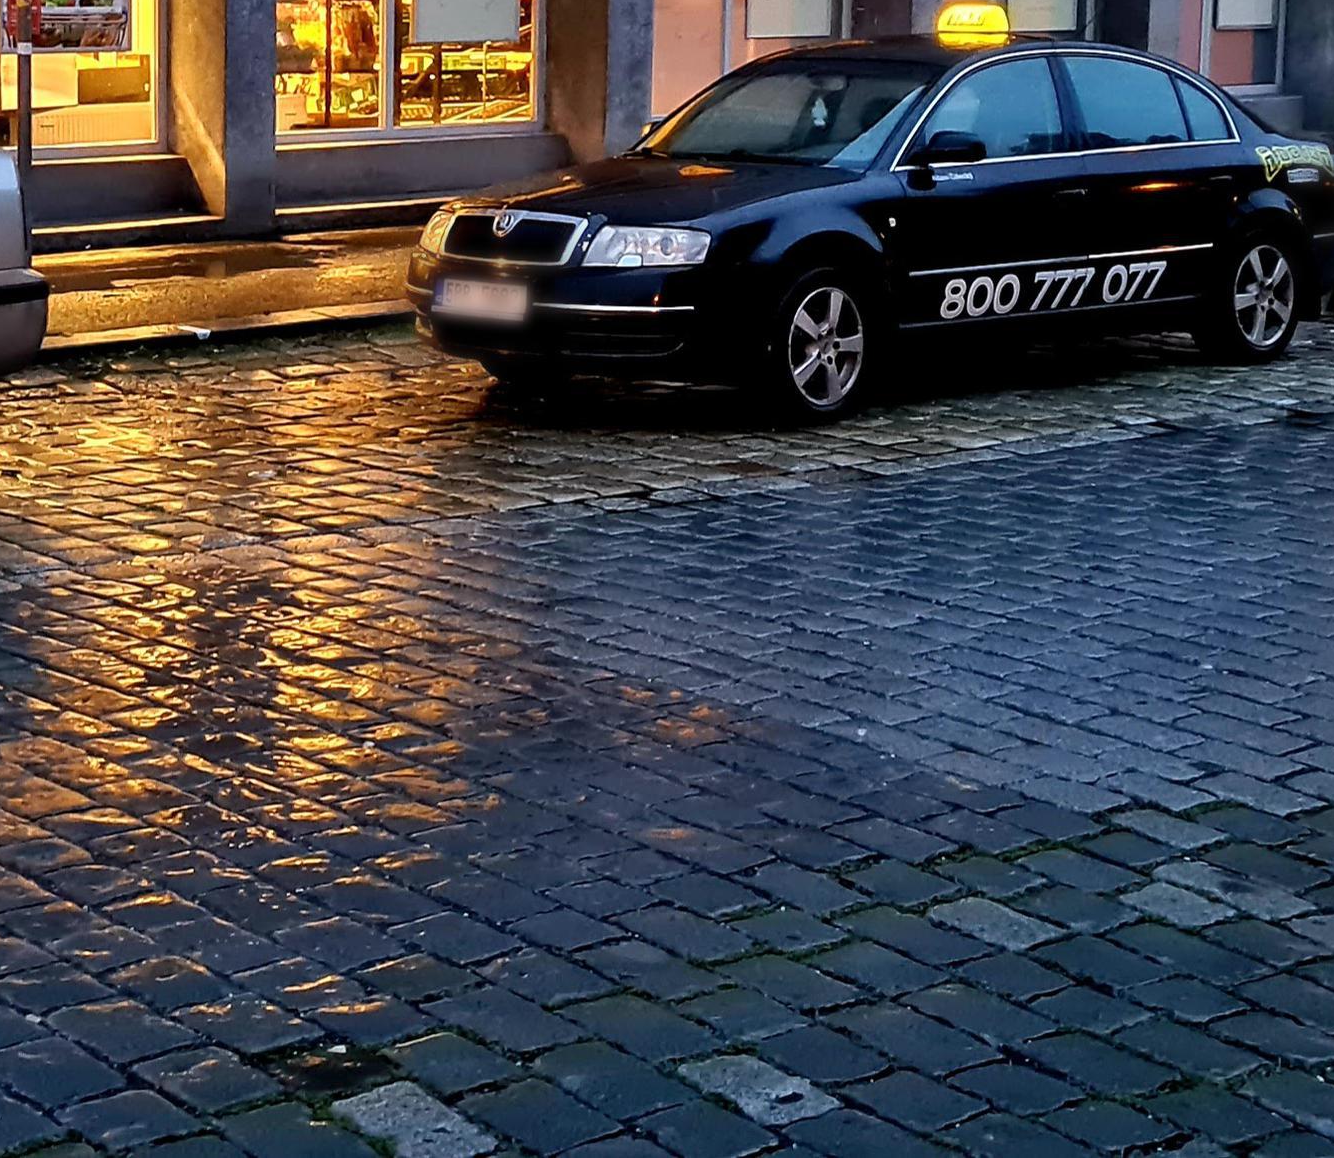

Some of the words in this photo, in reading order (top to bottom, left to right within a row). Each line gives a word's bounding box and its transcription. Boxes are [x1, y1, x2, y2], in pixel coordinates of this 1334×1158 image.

[940, 274, 1020, 319] 800
[1029, 267, 1095, 311] 777
[1102, 261, 1167, 303] 077
